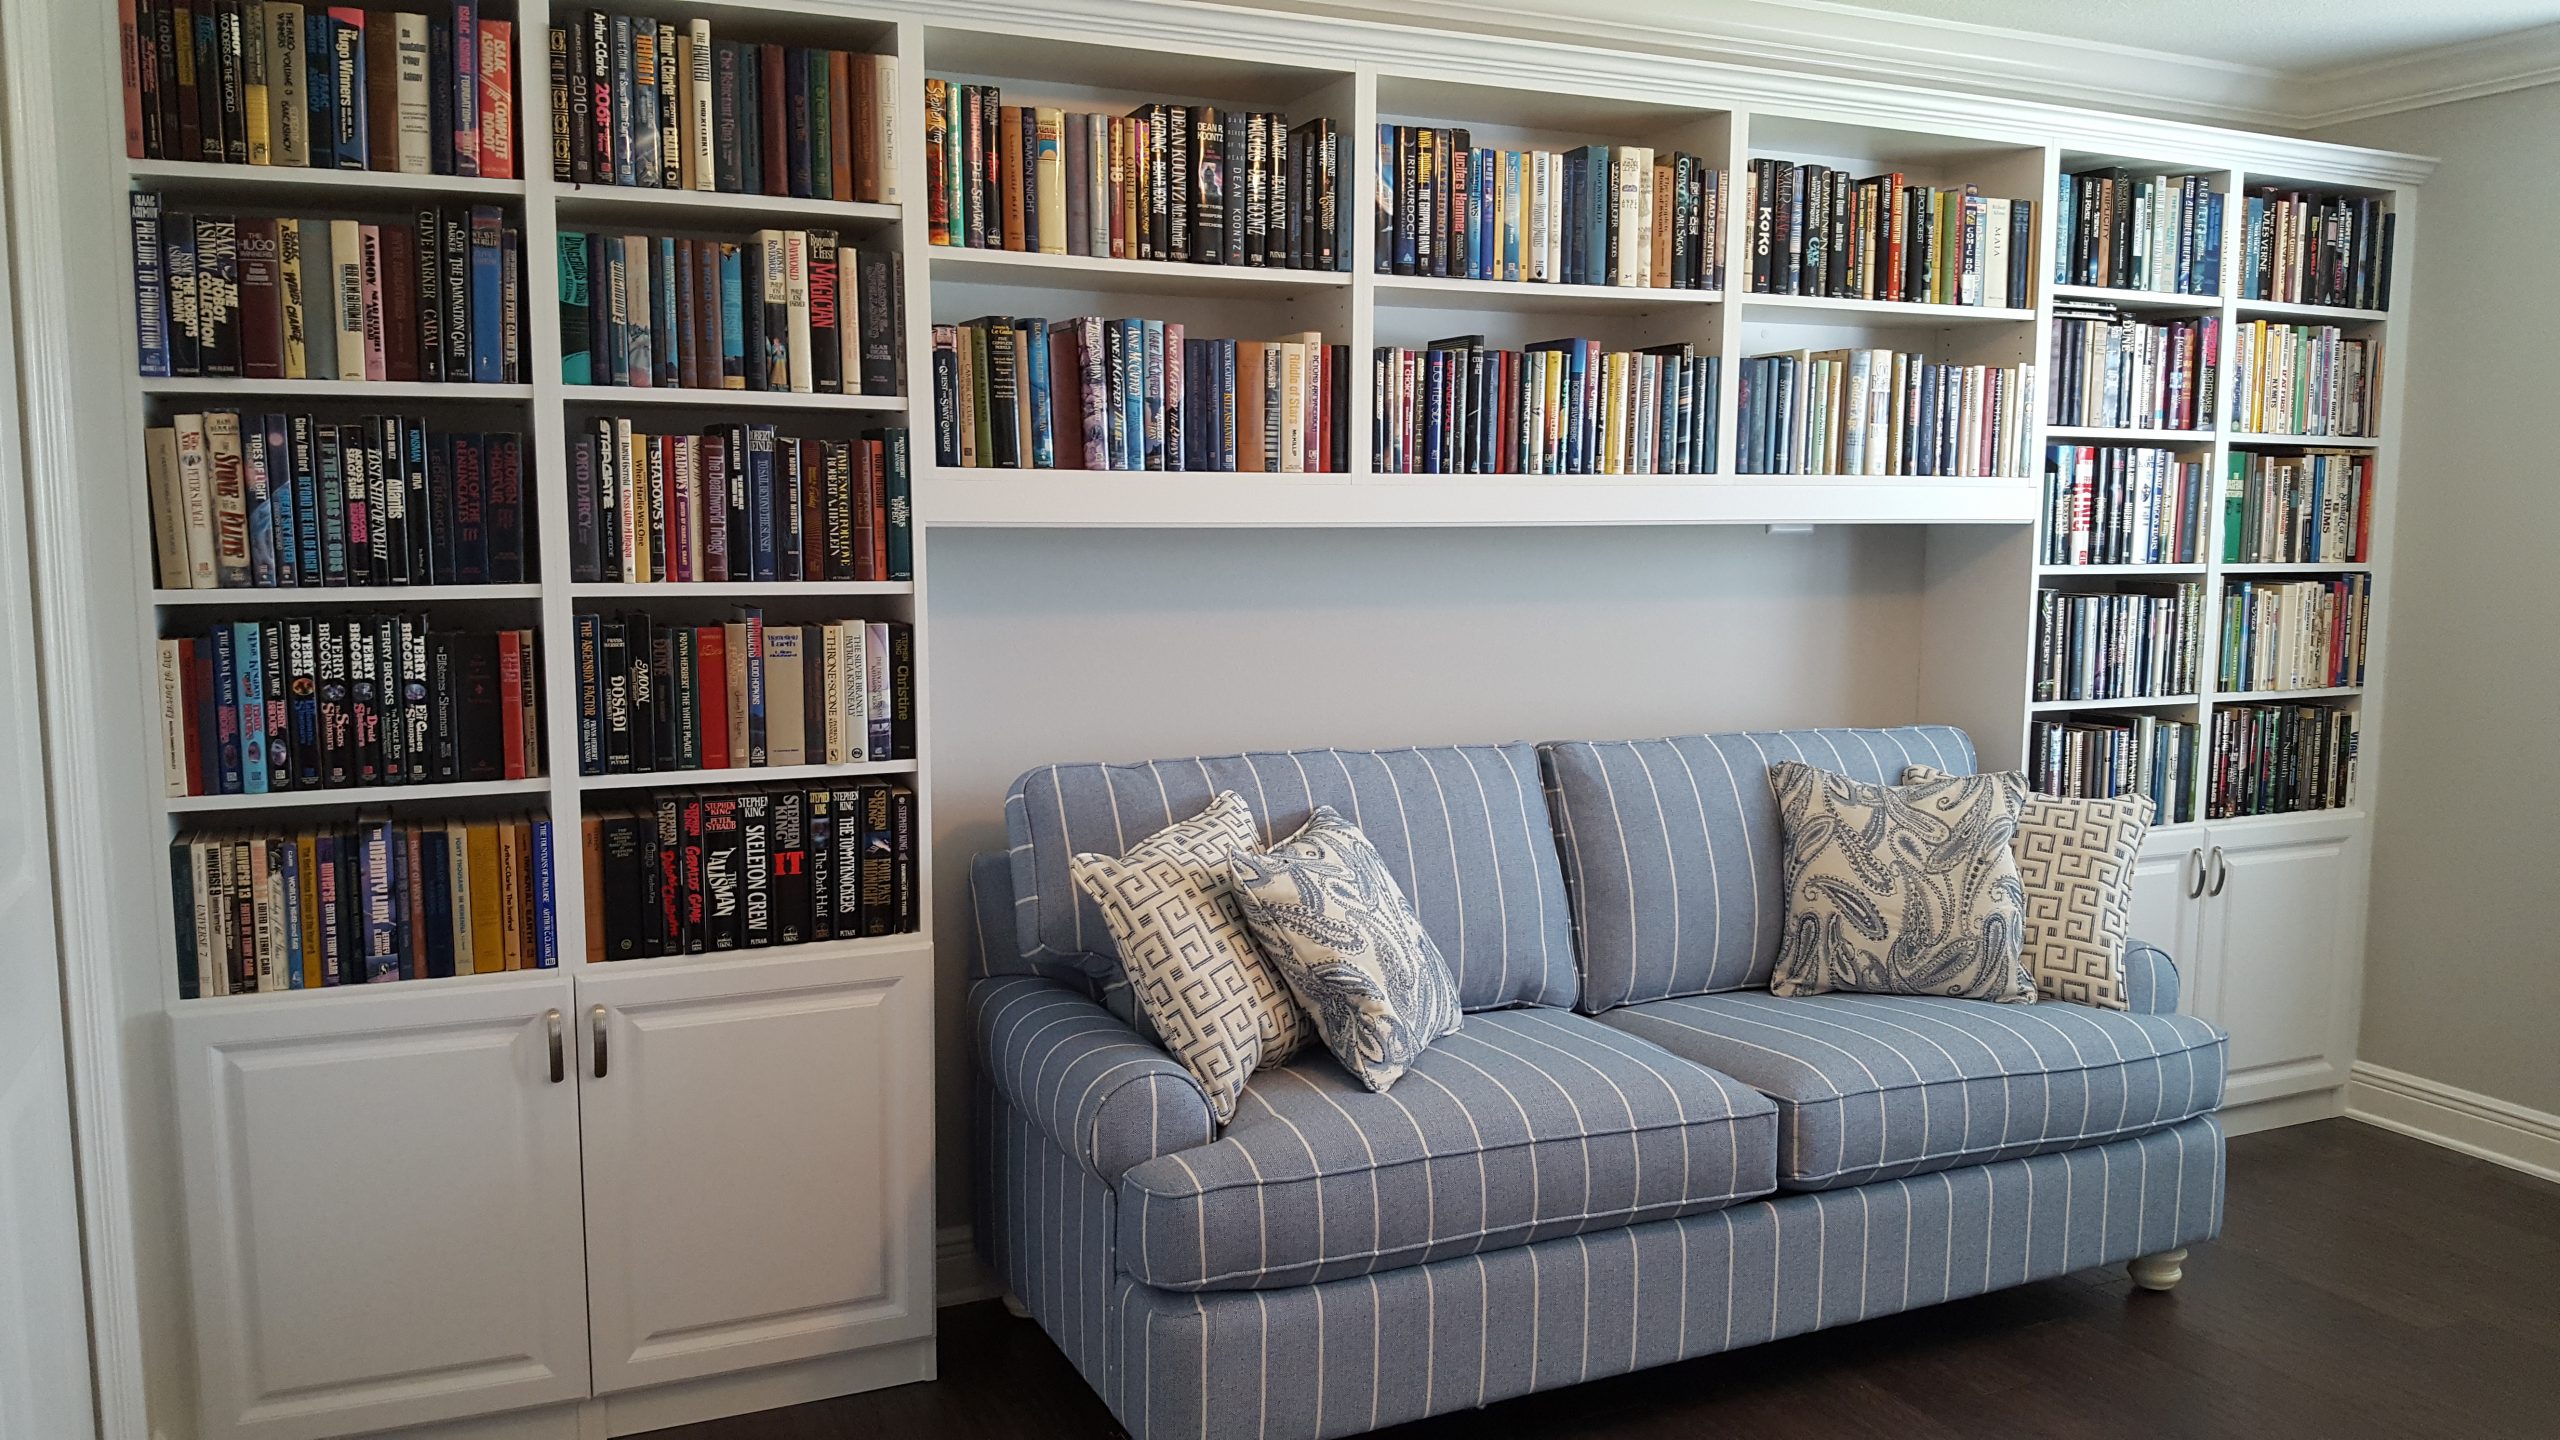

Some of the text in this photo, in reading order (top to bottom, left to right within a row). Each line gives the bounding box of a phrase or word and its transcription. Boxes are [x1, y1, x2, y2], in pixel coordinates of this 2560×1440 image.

[593, 12, 607, 40] Arthur
[660, 25, 674, 56] Arthur
[220, 13, 234, 112] WONDERS OF THE WORLD
[335, 29, 353, 106] Hugo Winners
[481, 31, 493, 78] ASIMOV
[495, 39, 506, 73] ISAAC
[596, 50, 608, 76] Clarke
[637, 35, 654, 74] RAMA
[573, 75, 587, 114] 2010
[662, 66, 676, 95] Clarke
[483, 112, 495, 152] ROBOT
[496, 100, 508, 159] COMPLETE
[1026, 178, 1035, 214] KNIGHT
[1171, 108, 1186, 248] DEAN KOONTZ Mr. Murder
[971, 188, 983, 234] SEMATARY
[1233, 168, 1242, 250] DEAN KOONTZ
[1406, 178, 1415, 240] MURDOCH
[1455, 194, 1467, 233] Hammer
[1677, 206, 1686, 256] CARL SAGAN
[1758, 208, 1772, 256] KOKO
[1820, 171, 1830, 250] COMMUNION
[2103, 186, 2111, 240] TRIPLICITY
[196, 220, 216, 270] ASIMOV
[216, 222, 236, 259] ISAAC
[565, 237, 587, 280] DANGEROUS
[789, 238, 801, 280] DAYWORLD
[1706, 220, 1714, 276] SCIENTISTS
[2260, 210, 2270, 272] JULES VERNE
[136, 220, 161, 348] PRELUDE TO FOUNDATION
[171, 276, 184, 321] OF DAWN
[212, 278, 226, 324] ROBOT
[225, 284, 237, 307] THE
[419, 211, 438, 350] CLIVE BARKER CABAL
[810, 262, 836, 328] MAGICIAN
[183, 276, 197, 337] THE ROBOTS
[200, 272, 214, 348] COLLECTION
[450, 258, 466, 357] THE DAMNATION GAME
[2122, 320, 2132, 351] DUNE
[1290, 354, 1300, 424] Riddle of Stars
[252, 434, 266, 500] TIDES OF LIGHT
[346, 448, 357, 500] SEA OF SUNS
[355, 450, 364, 499] ACROSS THE
[575, 442, 592, 528] LORD DARCY
[600, 420, 614, 510] STARGATE
[651, 450, 663, 519] SHADOWS
[298, 476, 318, 572] BEYOND THE FALL OF NIGHT
[324, 444, 344, 572] IF THE STARS ARE GODS
[386, 480, 403, 518] Atlantis
[636, 460, 645, 546] When Harlie Was One
[708, 456, 724, 555] The Deathworld Trilogy
[2322, 498, 2332, 534] BUMS
[350, 622, 363, 680] BROOKS
[362, 636, 375, 680] TERRY
[382, 622, 394, 705] TERRY BROOKS
[400, 622, 414, 680] BROOKS
[413, 636, 426, 682] TERRY
[580, 620, 595, 716] THE ASCENSION FACTOR
[827, 636, 837, 678] THRONE
[611, 676, 626, 732] DOSADI
[636, 659, 650, 703] MOON
[679, 632, 692, 758] FRANK HERBERT THE WHITE PLAGUE
[897, 666, 910, 720] Christine
[783, 795, 800, 848] STEPHEN
[833, 791, 860, 801] STEPHEN
[839, 802, 854, 811] KING
[868, 798, 877, 824] KING
[874, 790, 886, 830] STEPHEN
[776, 806, 788, 840] KING
[207, 848, 220, 888] UNIVERSE
[368, 840, 390, 924] INFINITY LINK
[706, 847, 737, 917] TALISMAN
[728, 871, 736, 888] THE
[746, 824, 767, 930] SKELETON CREW
[774, 850, 804, 876] IT
[816, 850, 829, 917] The Dark Half
[840, 816, 855, 912] THE TOMMYKNOCKERS
[864, 860, 877, 906] MIDNIGHT
[878, 858, 891, 904] FOUR PAST
